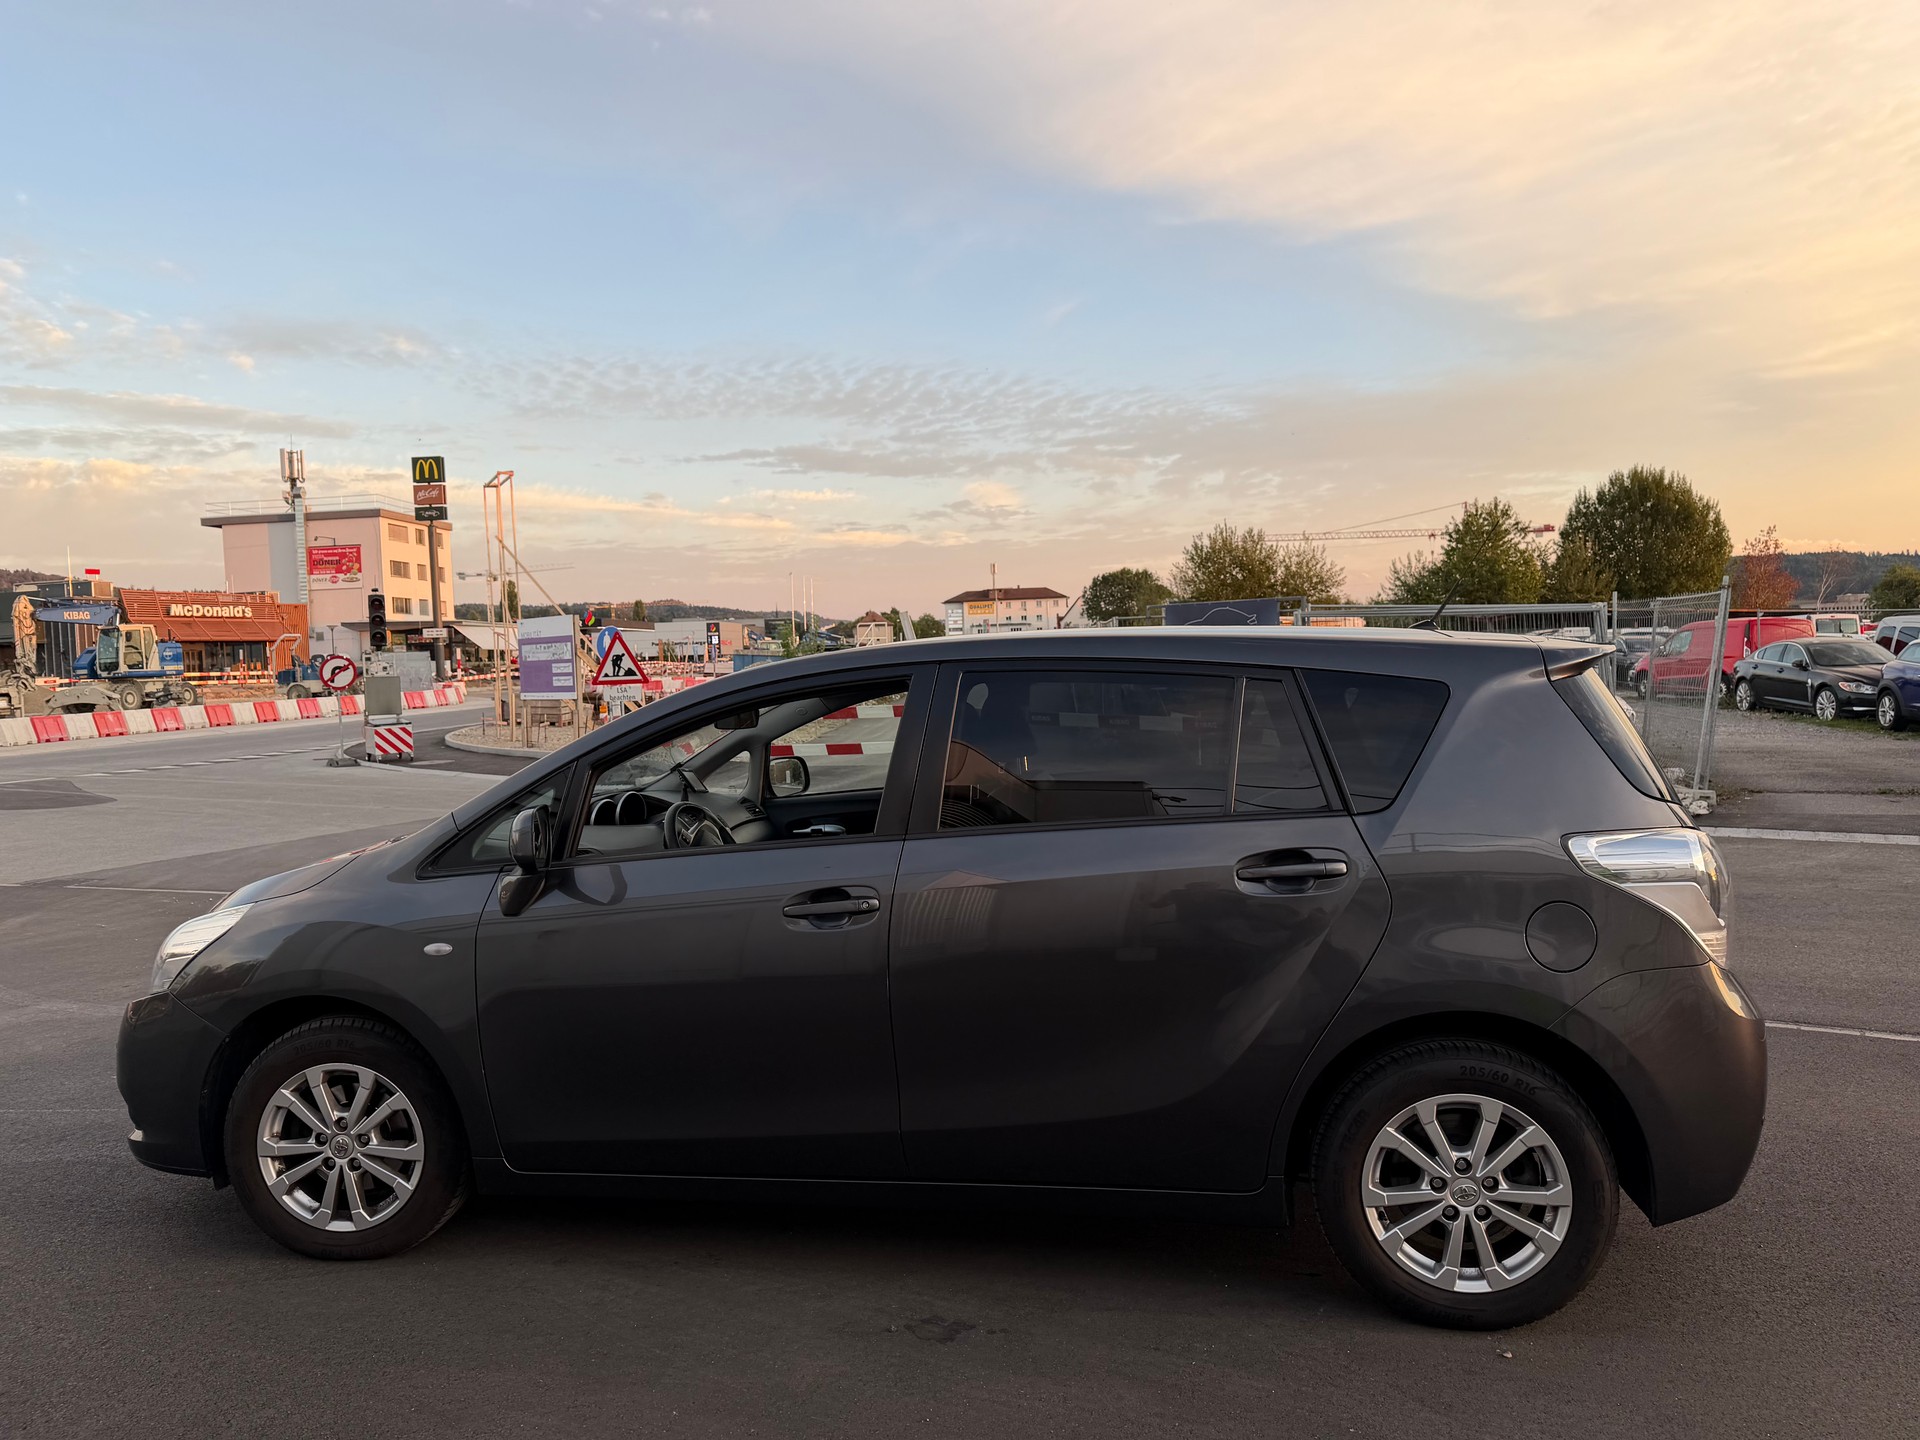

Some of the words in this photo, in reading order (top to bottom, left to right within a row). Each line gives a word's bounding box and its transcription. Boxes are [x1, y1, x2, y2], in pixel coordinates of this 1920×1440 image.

[63, 611, 91, 620] KIBAG
[169, 603, 252, 617] McDonald's
[609, 694, 637, 702] beachten
[1460, 1066, 1509, 1084] 205/60
[1514, 1077, 1539, 1096] R16
